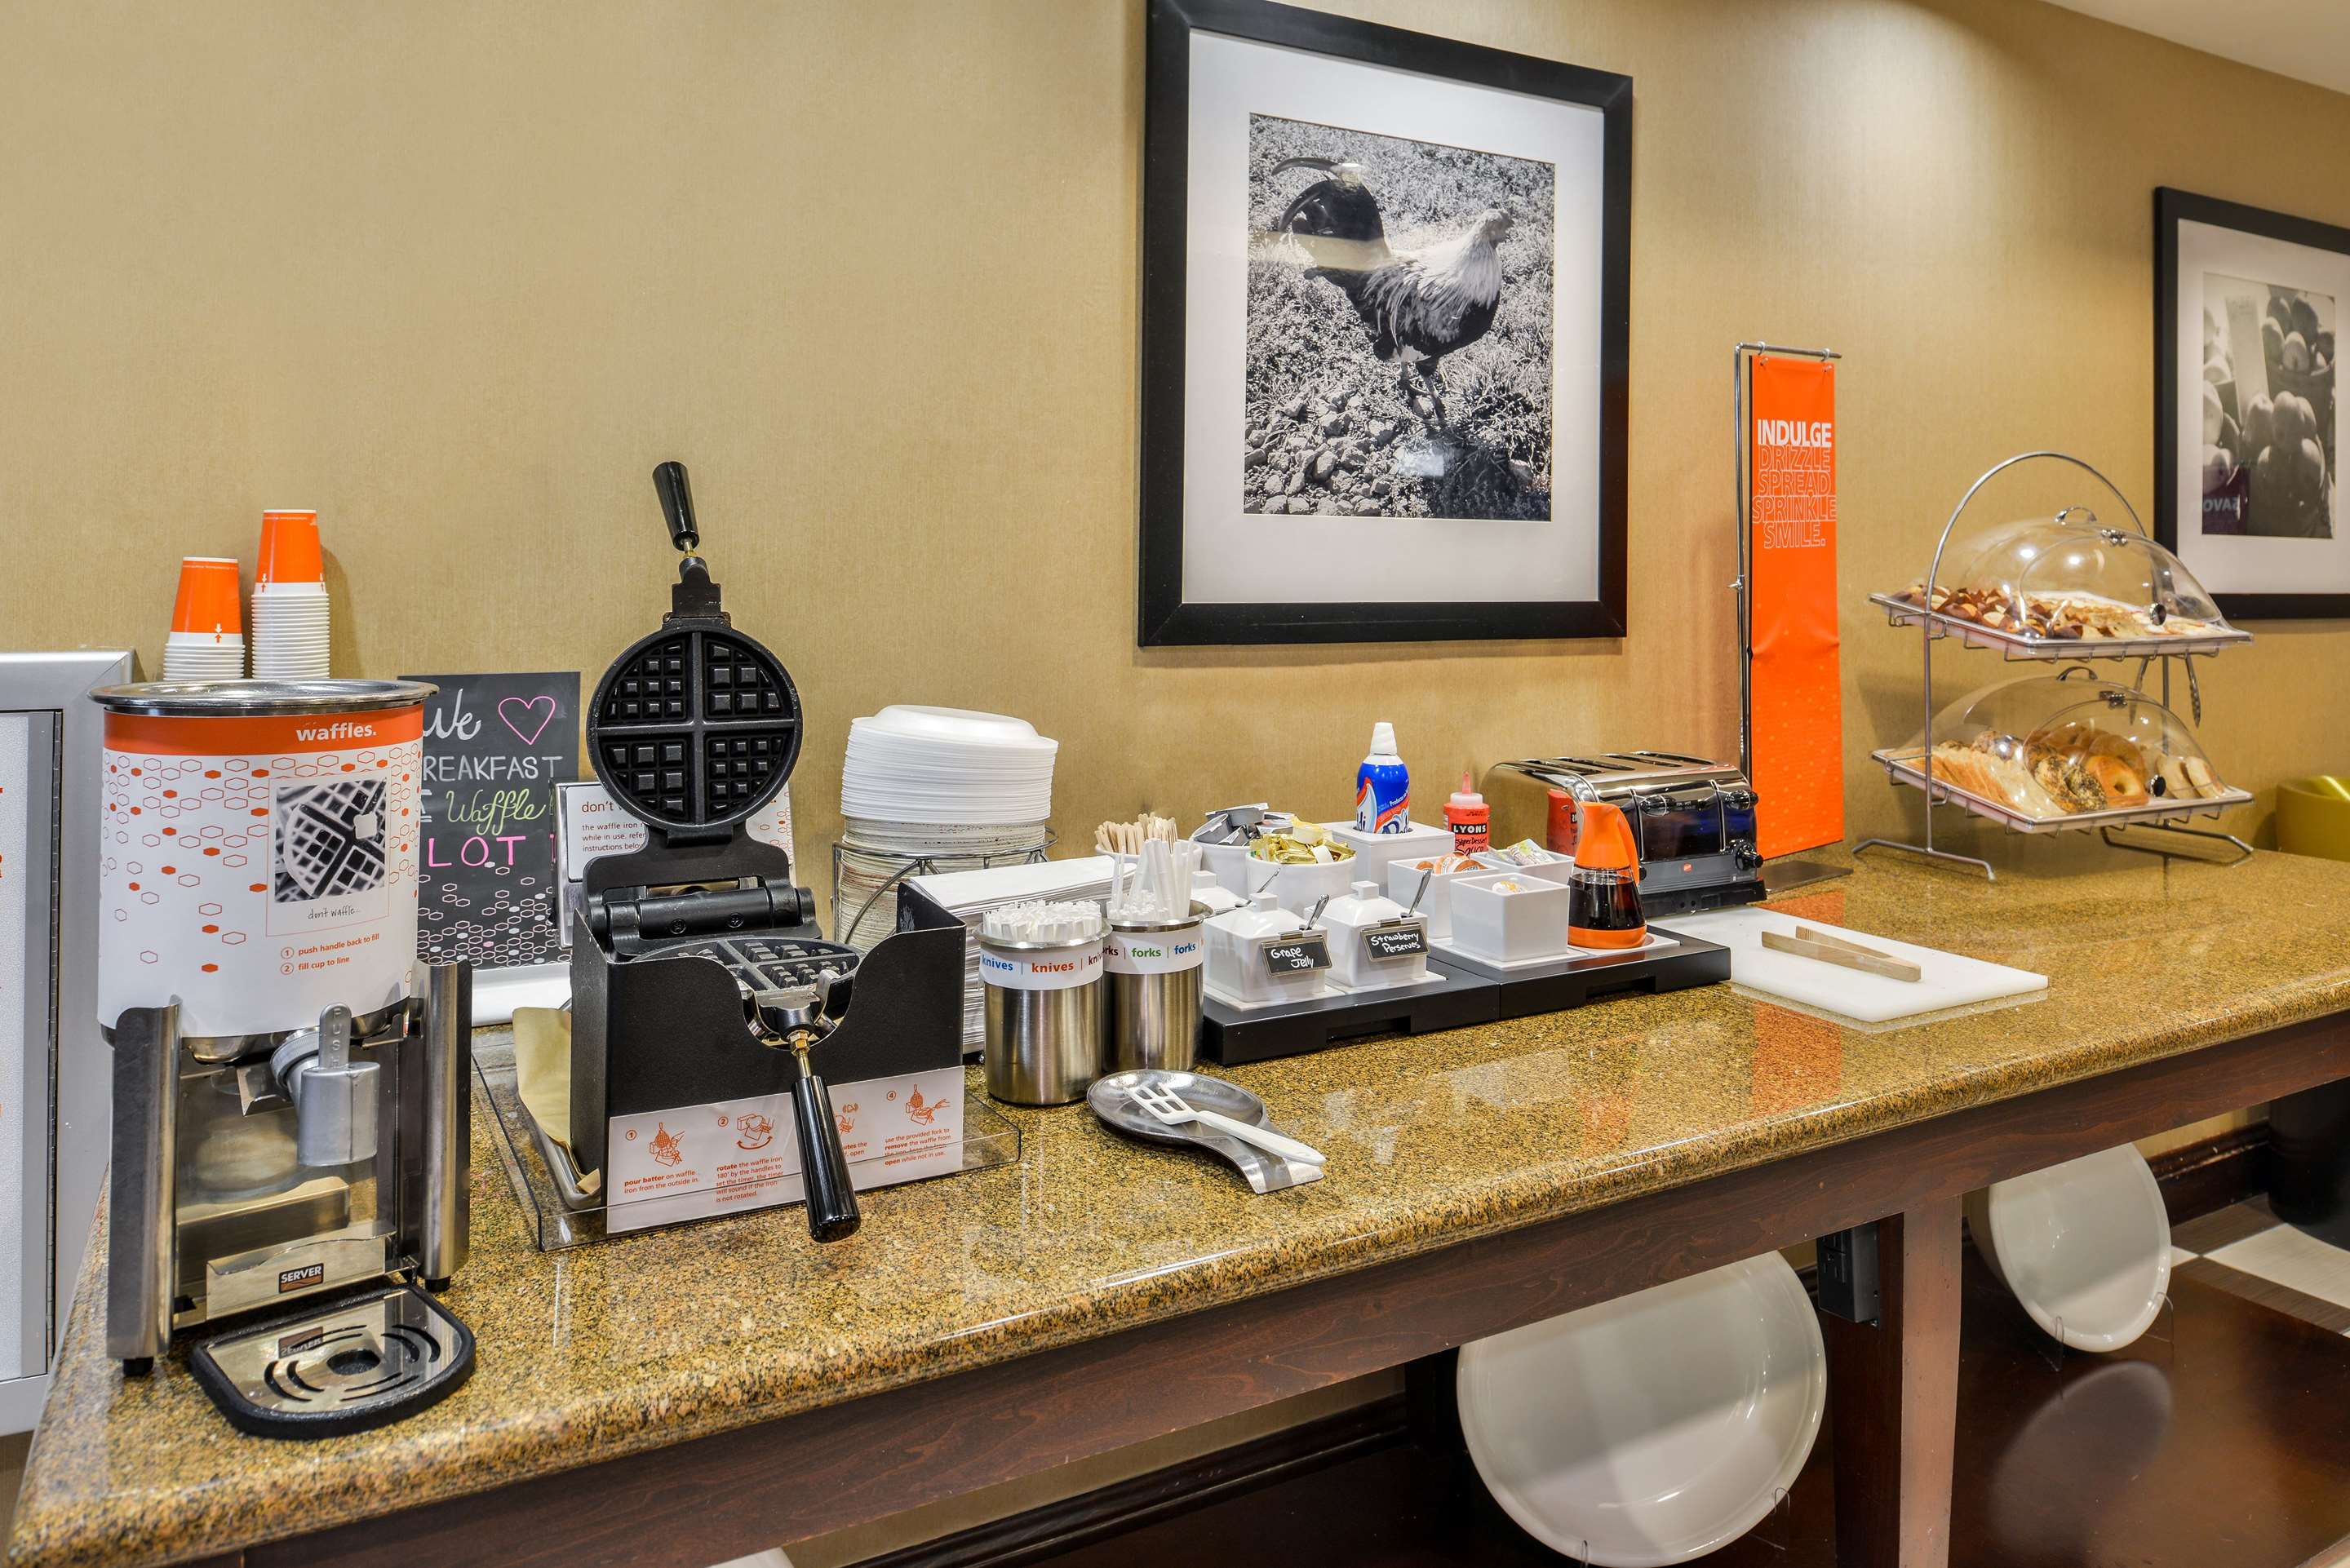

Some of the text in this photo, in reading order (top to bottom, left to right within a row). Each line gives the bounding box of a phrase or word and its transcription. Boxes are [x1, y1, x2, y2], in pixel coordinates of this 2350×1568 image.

[1758, 419, 1832, 448] INDULGE
[1759, 444, 1831, 472] DRIZZLE
[1758, 470, 1832, 497] SPREAD
[1752, 495, 1837, 524] SPRINKLE
[1763, 520, 1826, 549] SMILE.
[296, 722, 377, 742] waffles.
[423, 755, 563, 782] REAKFAST
[446, 788, 547, 836] Waffle
[582, 801, 614, 813] don't
[1453, 825, 1486, 833] LYONS
[428, 835, 526, 867] LOT
[583, 844, 623, 852] instructions
[1371, 932, 1419, 946] Strawberry
[298, 946, 318, 957] push
[320, 941, 345, 952] handle
[347, 938, 362, 947] back
[1132, 947, 1162, 958] forks
[1174, 942, 1196, 955] forks
[1270, 946, 1303, 959] Grape
[1382, 941, 1421, 954] Perserves
[298, 963, 308, 971] fill
[311, 962, 325, 970] cup
[337, 956, 349, 964] line
[982, 955, 1013, 971] knives
[1031, 961, 1074, 973] knives
[1290, 956, 1314, 968] Jelly
[906, 1131, 930, 1140] provided
[667, 1179, 691, 1187] outside
[729, 1185, 747, 1193] sound
[734, 1190, 758, 1199] rotated.
[281, 1265, 322, 1283] SERVER
